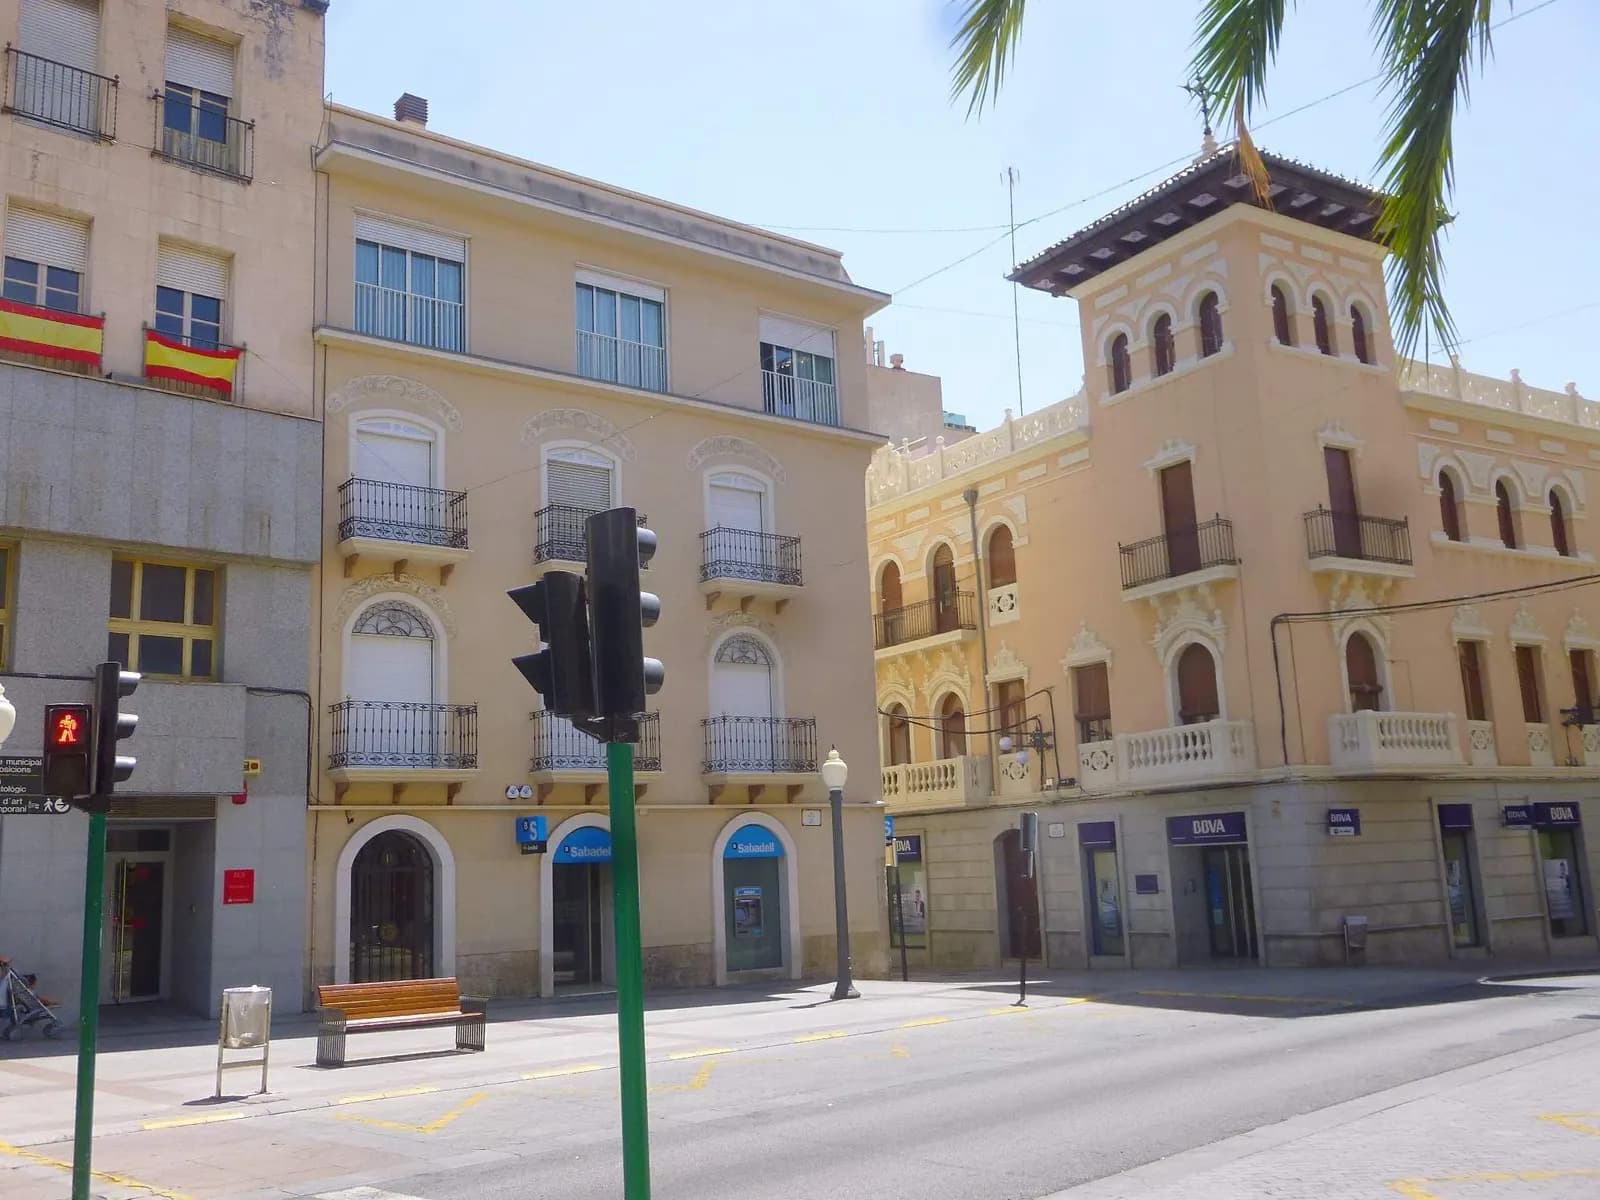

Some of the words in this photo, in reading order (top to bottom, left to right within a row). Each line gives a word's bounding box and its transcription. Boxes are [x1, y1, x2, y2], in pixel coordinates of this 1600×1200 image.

[6, 758, 42, 767] municipal
[1331, 812, 1352, 823] BBVA
[1507, 810, 1528, 818] BBVA
[1550, 807, 1574, 820] BBVA
[1193, 819, 1226, 834] BBVA
[570, 845, 612, 857] Sabadel
[738, 841, 775, 853] Sabadell
[896, 840, 911, 852] BVA
